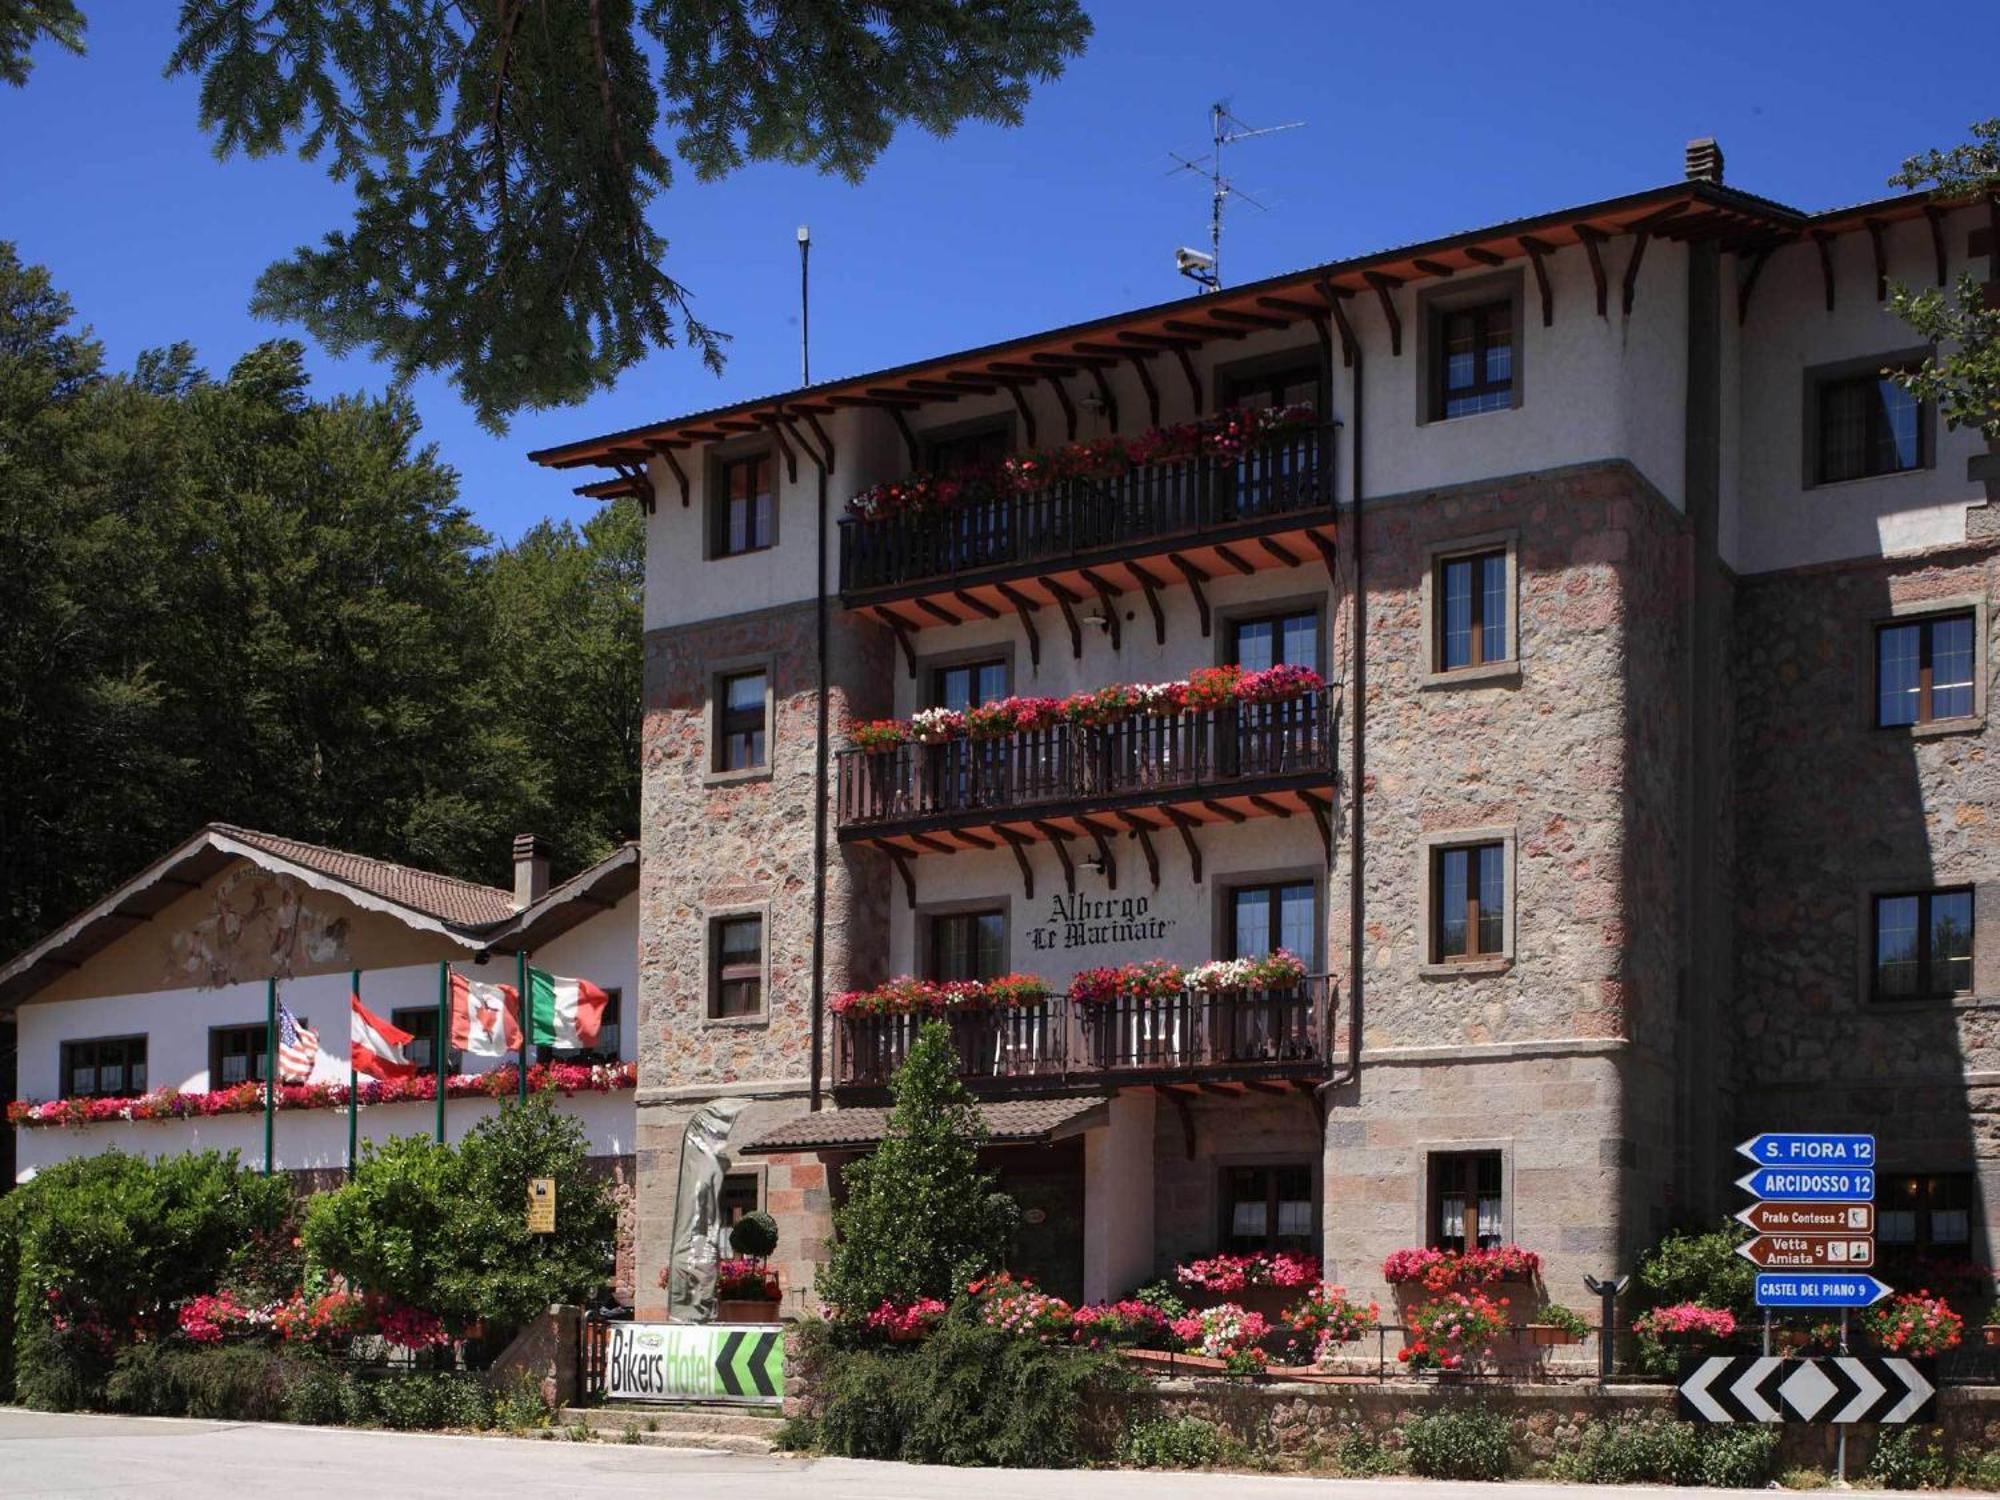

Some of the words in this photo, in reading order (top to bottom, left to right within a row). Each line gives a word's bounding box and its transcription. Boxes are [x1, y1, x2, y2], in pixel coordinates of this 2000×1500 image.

[1047, 892, 1149, 923] Albergo
[1765, 1142, 1783, 1158] S.
[1790, 1142, 1847, 1158] FIORA
[1853, 1143, 1871, 1158] 12
[1765, 1175, 1849, 1192] ARCIDOSSO
[1854, 1176, 1871, 1193] 12
[1762, 1211, 1789, 1224] Prato
[1792, 1212, 1836, 1224] Contessa
[1838, 1212, 1845, 1224] 2
[1772, 1238, 1808, 1250] Vetta
[1815, 1245, 1824, 1257] 5
[1766, 1252, 1813, 1264] Amiata
[1761, 1283, 1797, 1296] CASTEL
[1801, 1283, 1819, 1296] DEL
[1859, 1284, 1866, 1296] 9
[611, 1328, 664, 1394] Bikers
[666, 1330, 714, 1395] Hotel
